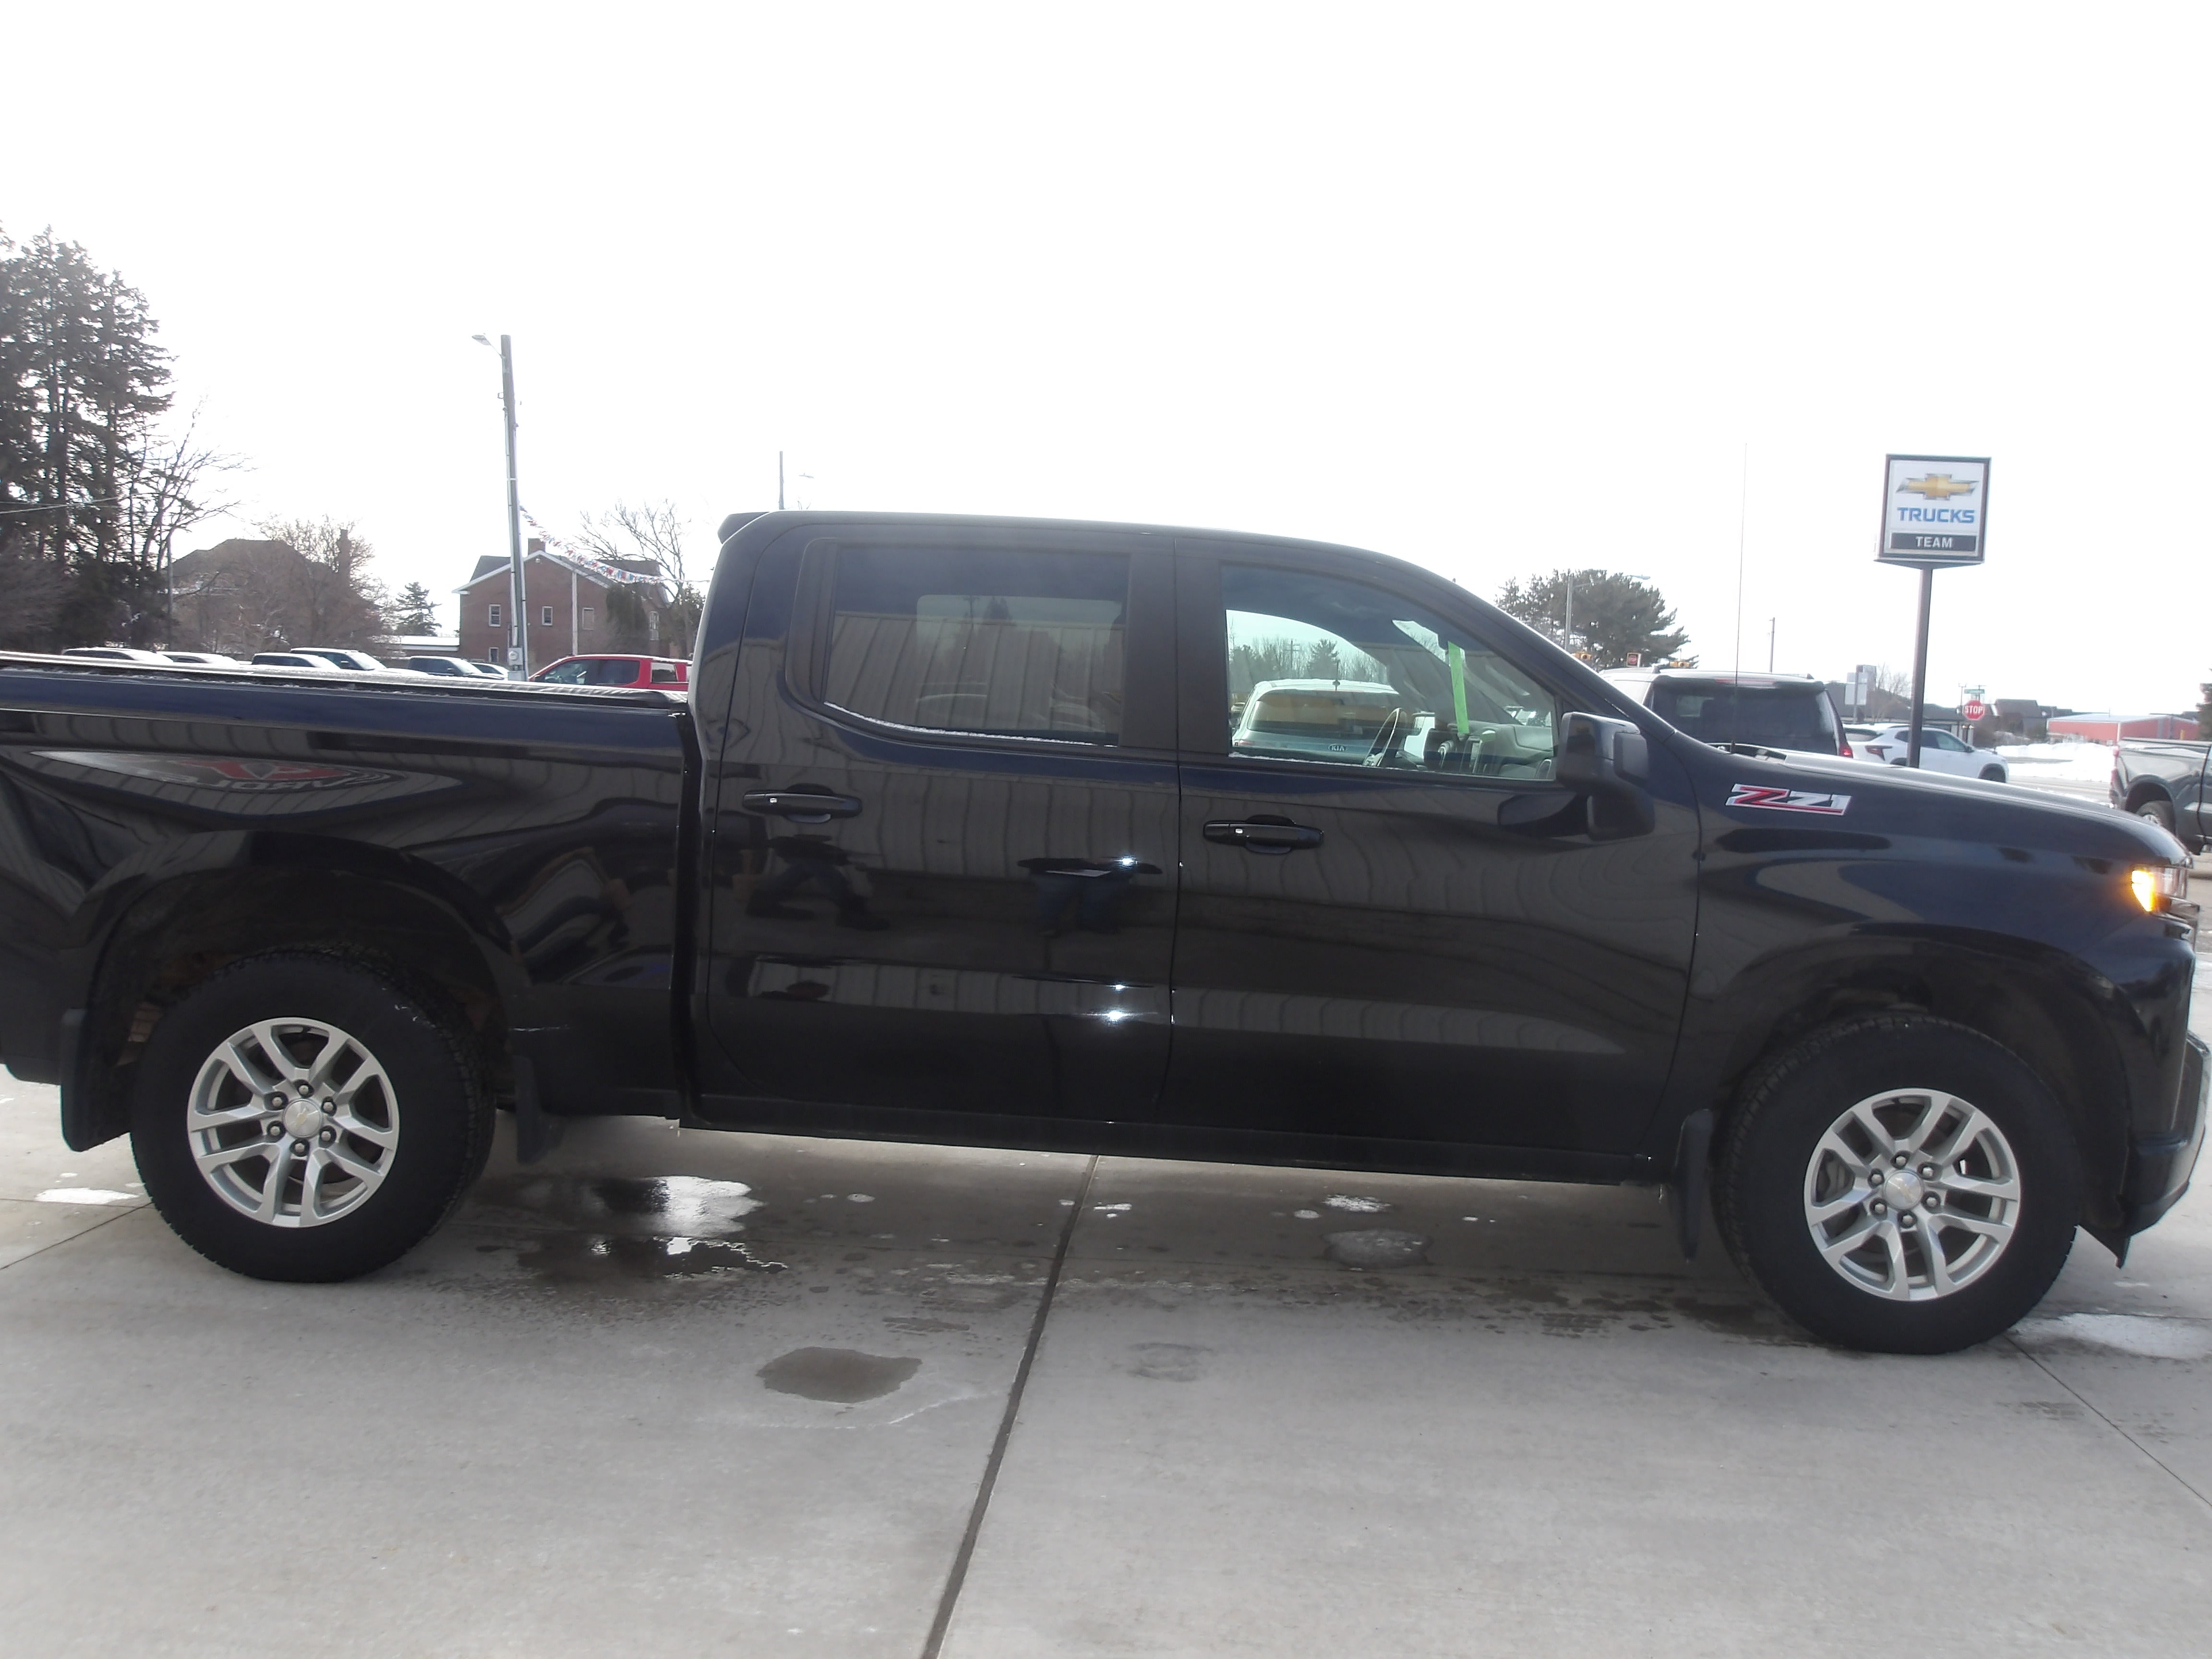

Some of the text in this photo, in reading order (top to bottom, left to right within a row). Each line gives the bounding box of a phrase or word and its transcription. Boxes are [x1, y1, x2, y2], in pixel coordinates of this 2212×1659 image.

[1897, 507, 1975, 523] TRUCKS
[1915, 536, 1953, 548] TEAM
[1964, 706, 1983, 714] STOP
[1725, 783, 1851, 816] Z71
